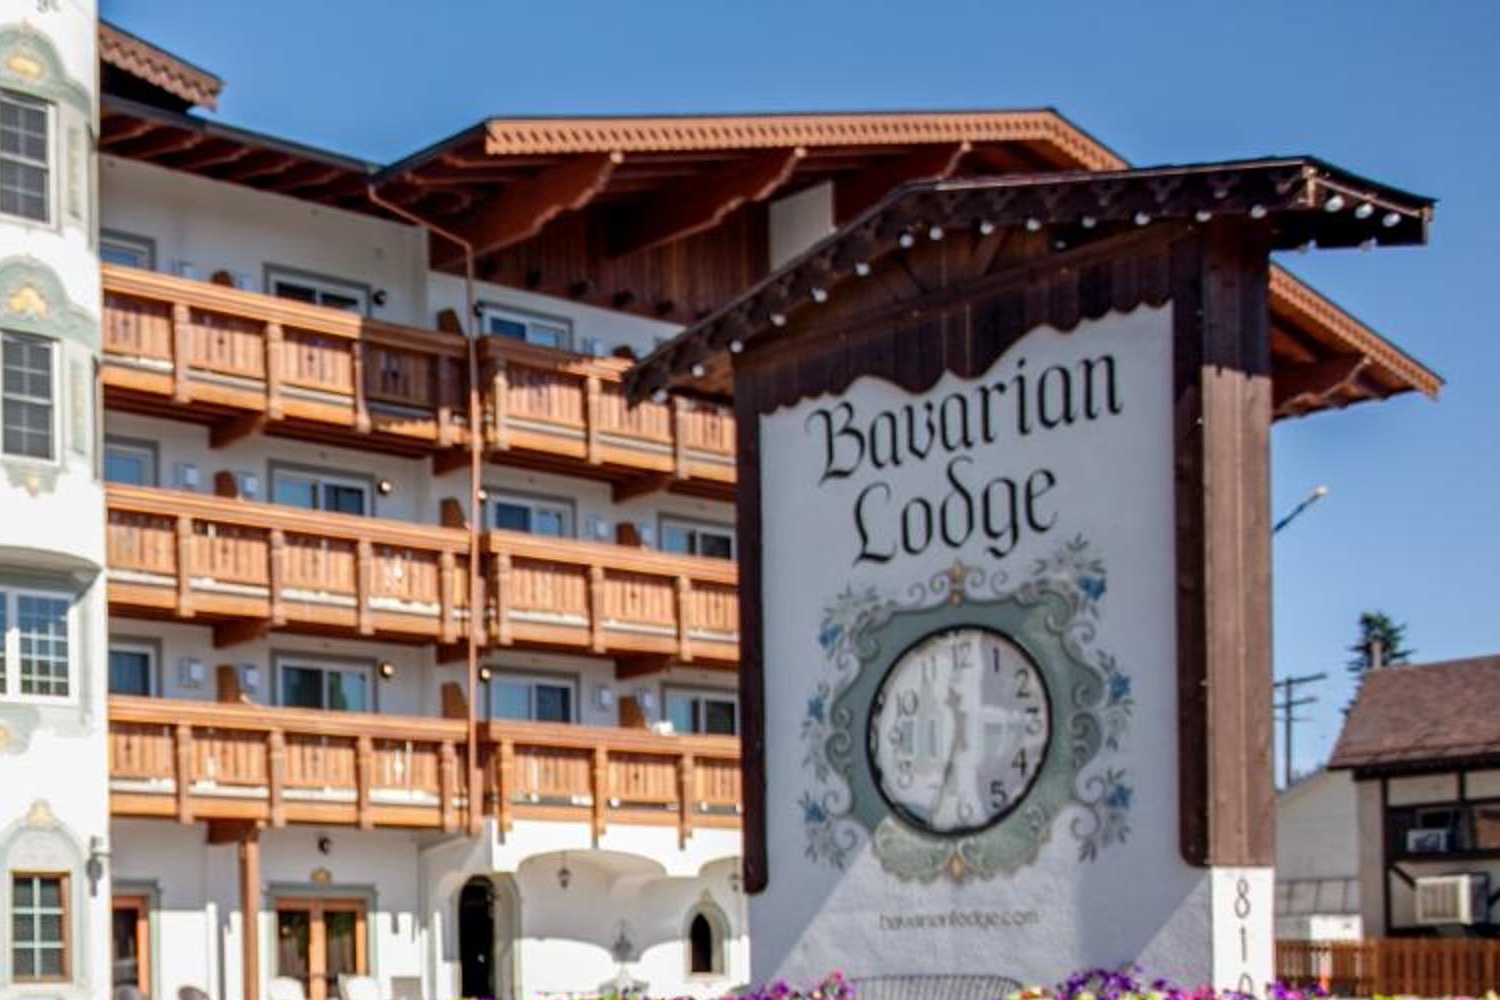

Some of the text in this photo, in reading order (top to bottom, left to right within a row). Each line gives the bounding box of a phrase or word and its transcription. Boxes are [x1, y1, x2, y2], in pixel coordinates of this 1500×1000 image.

[807, 353, 1122, 486] Bavarian
[852, 455, 1057, 565] Lodge
[1015, 668, 1030, 699] 2
[1012, 749, 1029, 778] 4
[990, 780, 1007, 808] 5
